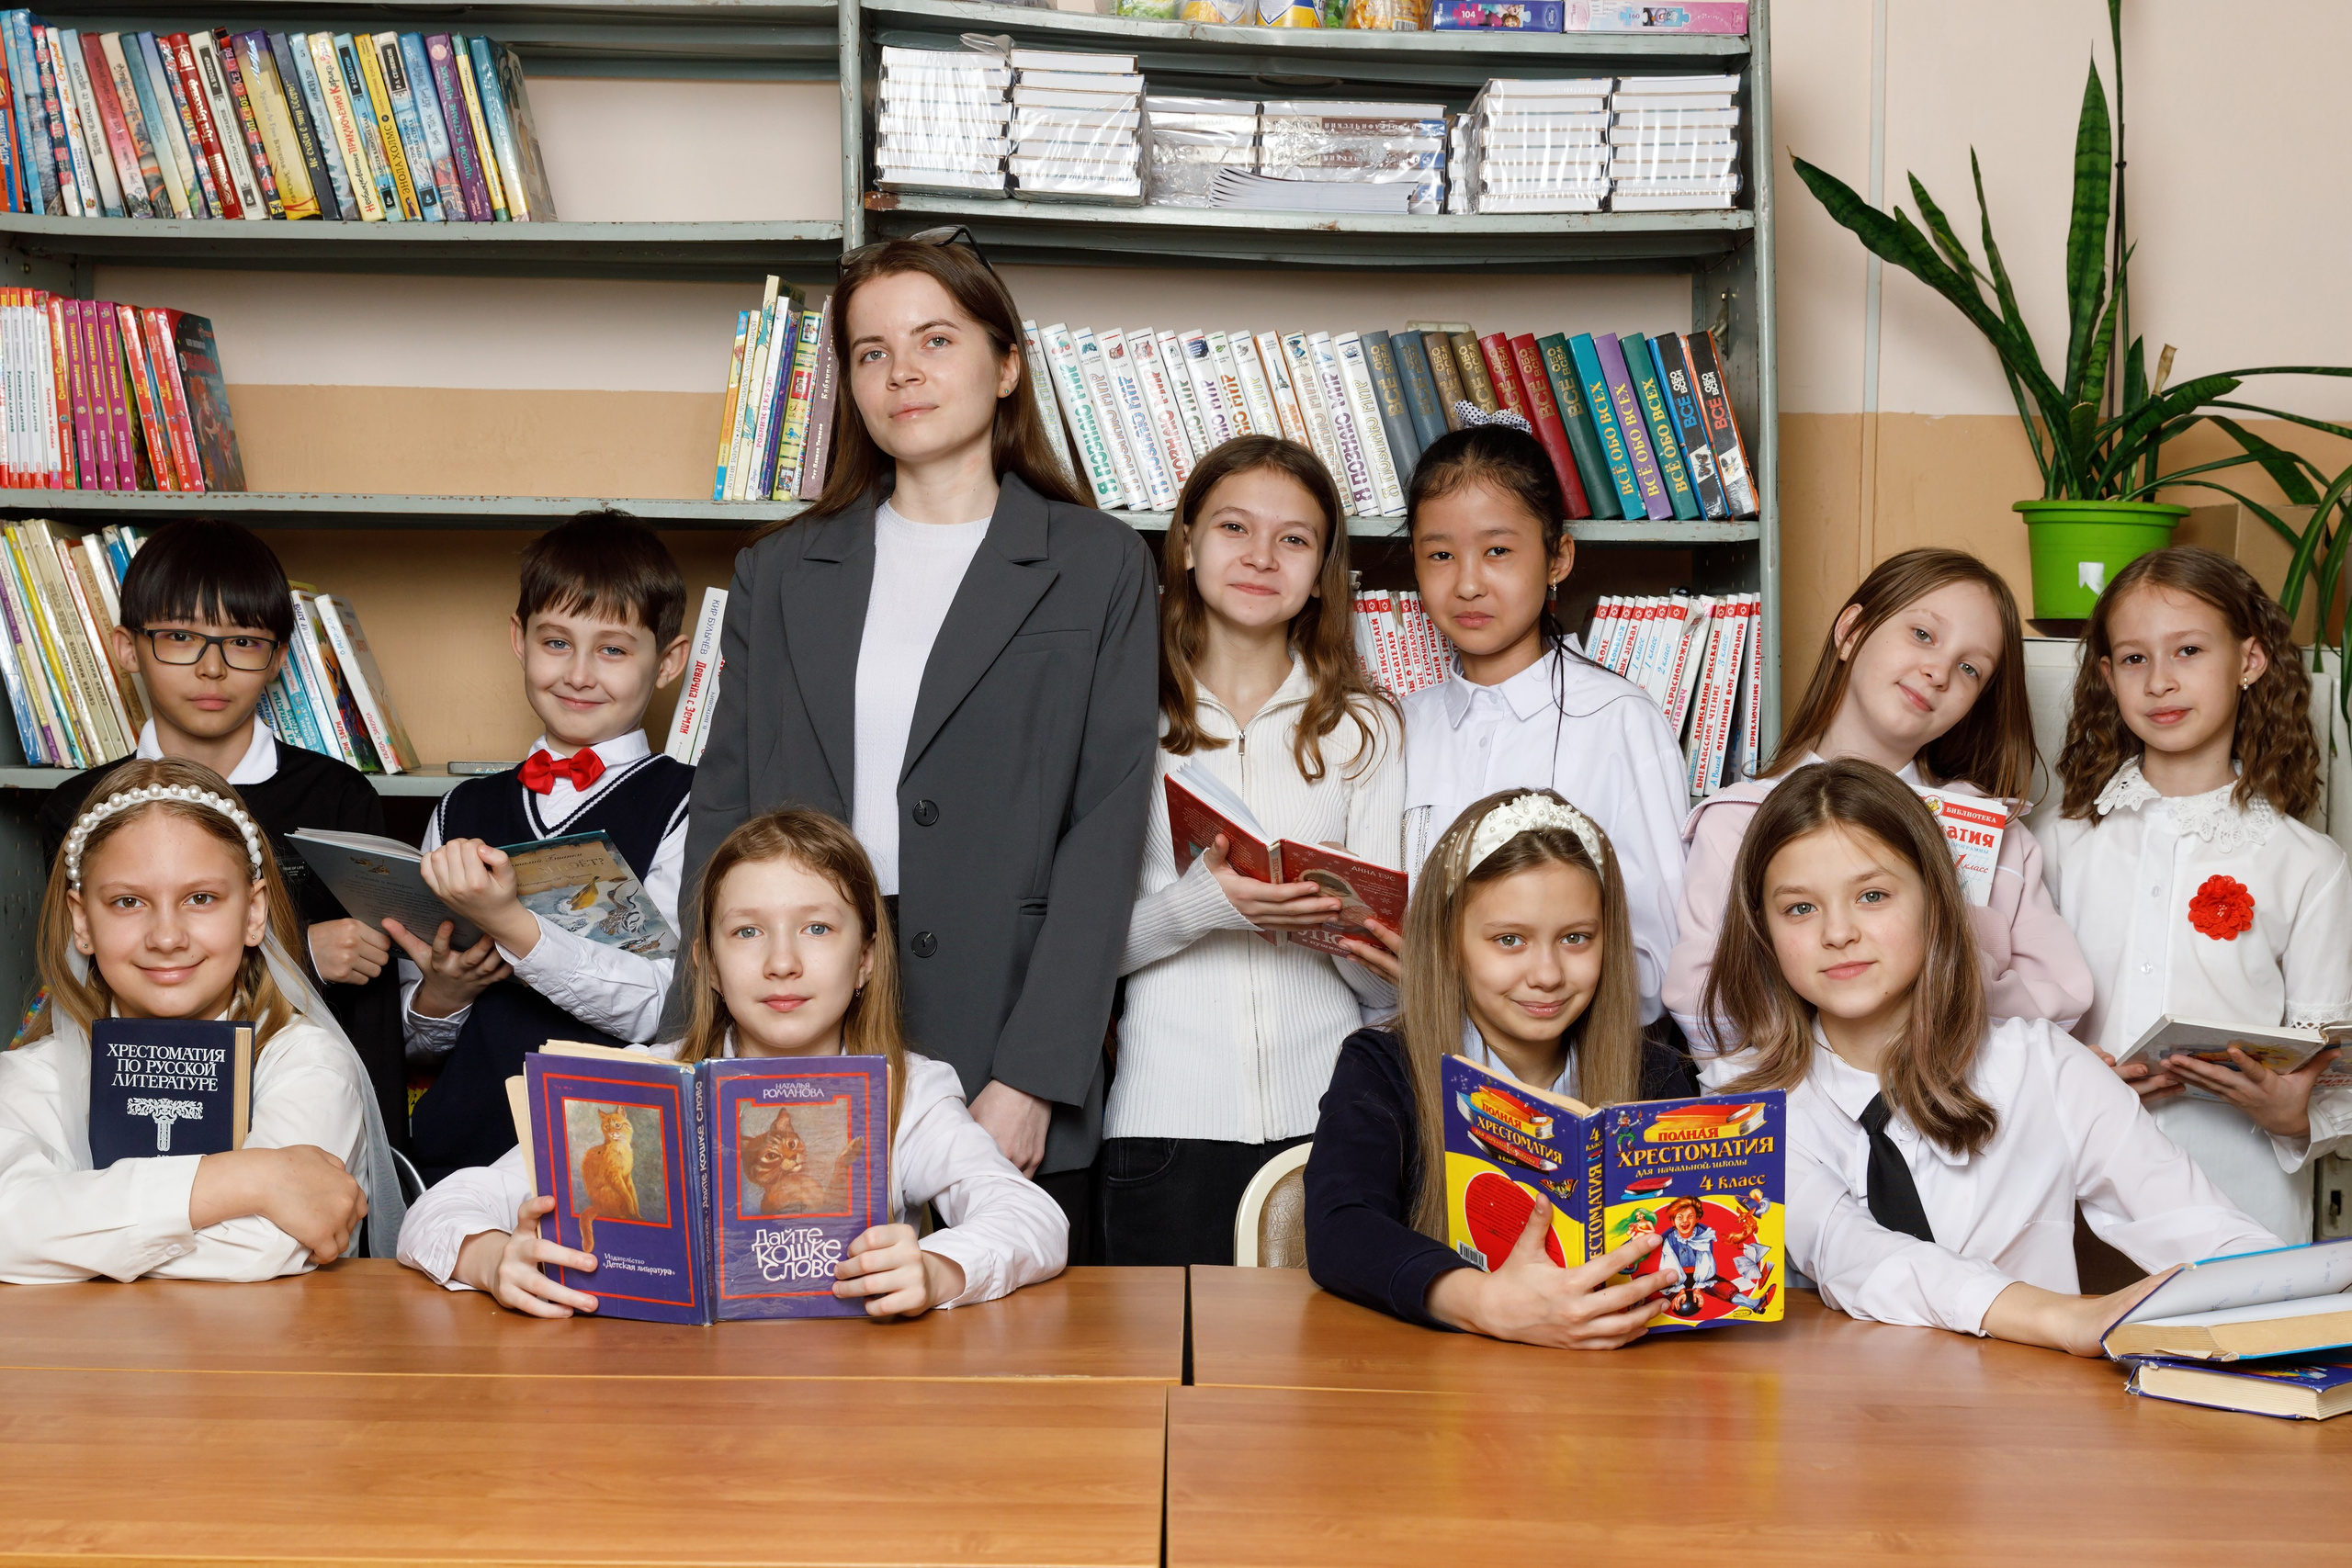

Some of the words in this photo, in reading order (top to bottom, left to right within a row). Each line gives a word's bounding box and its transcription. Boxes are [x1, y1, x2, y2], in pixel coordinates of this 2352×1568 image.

[1462, 10, 1476, 19] 104
[49, 39, 67, 83] Сидоров
[222, 46, 245, 94] СОСЕДСТВО
[386, 46, 399, 78] СТИВЕНСОН
[321, 63, 342, 95] Карика
[438, 64, 454, 100] ЧУЖИХ
[185, 77, 209, 123] Буссенар
[237, 94, 257, 133] ОПАСНОЕ
[180, 105, 198, 142] ТАЙНА
[198, 121, 215, 144] Луи
[294, 108, 307, 126] эту
[331, 94, 358, 154] ПРИКЛЮЧЕНИЯ
[447, 102, 462, 136] СТРАНЕ
[366, 128, 378, 153] КАПИТАНА
[383, 123, 401, 161] ХОЛМС
[374, 154, 385, 176] ОДИССЕЯ
[394, 160, 411, 195] ЭНОЛА
[456, 143, 474, 180] ЧУЖОЙ
[349, 152, 376, 213] Необыкновенные
[1369, 344, 1384, 371] ОБО
[1379, 342, 1393, 374] ВСЕМ
[1430, 346, 1444, 373] ОБО
[1440, 344, 1454, 375] ВСЕМ
[1457, 344, 1474, 372] ОБО
[1466, 342, 1483, 373] ВСЕМ
[1487, 347, 1502, 374] ОБО
[1497, 344, 1512, 377] ВСЕМ
[1519, 347, 1532, 374] ОБО
[1527, 344, 1542, 377] ВСЕМ
[1546, 345, 1561, 372] ОБО
[1555, 344, 1571, 375] ВСЕМ
[763, 376, 773, 403] КРУЗО
[1059, 360, 1087, 402] МИР
[1088, 370, 1114, 409] МИР
[1116, 372, 1141, 412] МИР
[1142, 367, 1168, 408] МИР
[1171, 376, 1197, 414] МИР
[1198, 377, 1221, 412] МИР
[1218, 370, 1244, 410] МИР
[1244, 373, 1268, 411] МИР
[1296, 369, 1322, 412] МИР
[1322, 369, 1345, 410] МИР
[1350, 376, 1375, 415] МИР
[1668, 370, 1680, 391] ОБО
[1674, 368, 1688, 393] ВСЕМ
[1701, 372, 1712, 393] ОБО
[1707, 370, 1719, 396] ВСЕМ
[1589, 378, 1611, 424] ВСЕХ
[1613, 381, 1637, 426] ВСЕХ
[1641, 376, 1666, 423] ВСЕХ
[1277, 399, 1303, 435] МИР
[1073, 401, 1112, 479] ПОЗНАЮ
[1101, 407, 1135, 478] ПОЗНАЮ
[1129, 410, 1164, 480] ПОЗНАЮ
[1156, 408, 1190, 483] ПОЗНАЮ
[1333, 410, 1367, 487] ПОЗНАЮ
[1362, 413, 1395, 484] ПОЗНАЮ
[1601, 424, 1624, 462] ОБО
[1627, 427, 1649, 463] ОБО
[1655, 423, 1678, 459] ОБО
[1096, 478, 1118, 496] Я
[1122, 478, 1139, 494] Я
[1150, 479, 1169, 496] Я
[1380, 483, 1399, 500] Я
[1611, 462, 1634, 496] ВСЁ
[1636, 463, 1660, 498] ВСЁ
[1663, 458, 1688, 494] ВСЁ
[1351, 486, 1372, 502] Я
[293, 603, 306, 623] ДУРОВ
[708, 598, 720, 615] КИР
[1411, 598, 1422, 631] СКАЗОК
[697, 616, 718, 656] БУЛЫЧЁВ
[1369, 617, 1388, 674] ПИСАТЕЛЕЙ
[1398, 633, 1410, 667] ШКОЛЕ
[1404, 614, 1421, 669] «ПРИКОЛЫ»
[1424, 617, 1438, 653] ГРЕЦИИ
[1587, 634, 1599, 659] класс
[1623, 624, 1637, 656] ЗЕРКАЛ
[1634, 636, 1645, 660] класс
[1646, 635, 1657, 660] класс
[1729, 622, 1744, 675] МАРРАНОВ
[68, 640, 85, 678] МИХАЛКОВ
[80, 641, 97, 679] МИХАЛКОВ
[1385, 630, 1404, 688] ПИСАТЕЛЕЙ
[1419, 634, 1431, 677] ГЕРОЯМИ
[1656, 665, 1666, 675] 2
[1659, 641, 1671, 667] класс
[1666, 632, 1690, 705] КРАСНОКОЖИХ
[82, 680, 95, 706] СЕРГЕЙ
[95, 681, 107, 706] СЕРГЕЙ
[685, 660, 707, 699] Девочка
[1693, 682, 1710, 740] ДЕНИСКИНЫ
[1705, 629, 1720, 679] РАССКАЗЫ
[1725, 676, 1734, 695] БОГ
[271, 689, 291, 731] ЛОПУХАСТЫХ
[365, 711, 379, 737] ЗВЕРЯТА
[677, 705, 695, 735] Земли
[1695, 722, 1713, 789] ВНЕКЛАССНОЕ
[1707, 683, 1720, 721] ЧТЕНИЕ
[1719, 634, 1728, 659] класс
[1714, 698, 1730, 751] ОГНЕННЫЙ
[1748, 684, 1758, 748] ПРИКЛЮЧЕНИЯ
[334, 719, 347, 740] ЗВЕРИ
[1946, 807, 1996, 823] БИБЛИОТЕКА
[1351, 865, 1376, 877] АННА
[1962, 864, 1988, 873] класс
[107, 1043, 226, 1063] ХРЕСТОМАТИЯ
[117, 1058, 141, 1073] ПО
[146, 1060, 216, 1077] РУССКОЙ
[111, 1073, 218, 1091] ЛИТЕРАТУРЕ
[763, 1088, 824, 1099] РОМАНОВА
[1482, 1103, 1521, 1130] ПОЛНАЯ
[1476, 1116, 1562, 1164] ХРЕСТОМАТИЯ
[1589, 1128, 1600, 1141] 4
[1657, 1127, 1719, 1141] ПОЛНАЯ
[1617, 1136, 1775, 1168] ХРЕСТОМАТИЯ
[1635, 1168, 1654, 1178] для
[1657, 1162, 1712, 1174] начальной
[1712, 1159, 1747, 1168] школы
[1700, 1175, 1713, 1190] 4
[752, 1227, 823, 1251] Дайте
